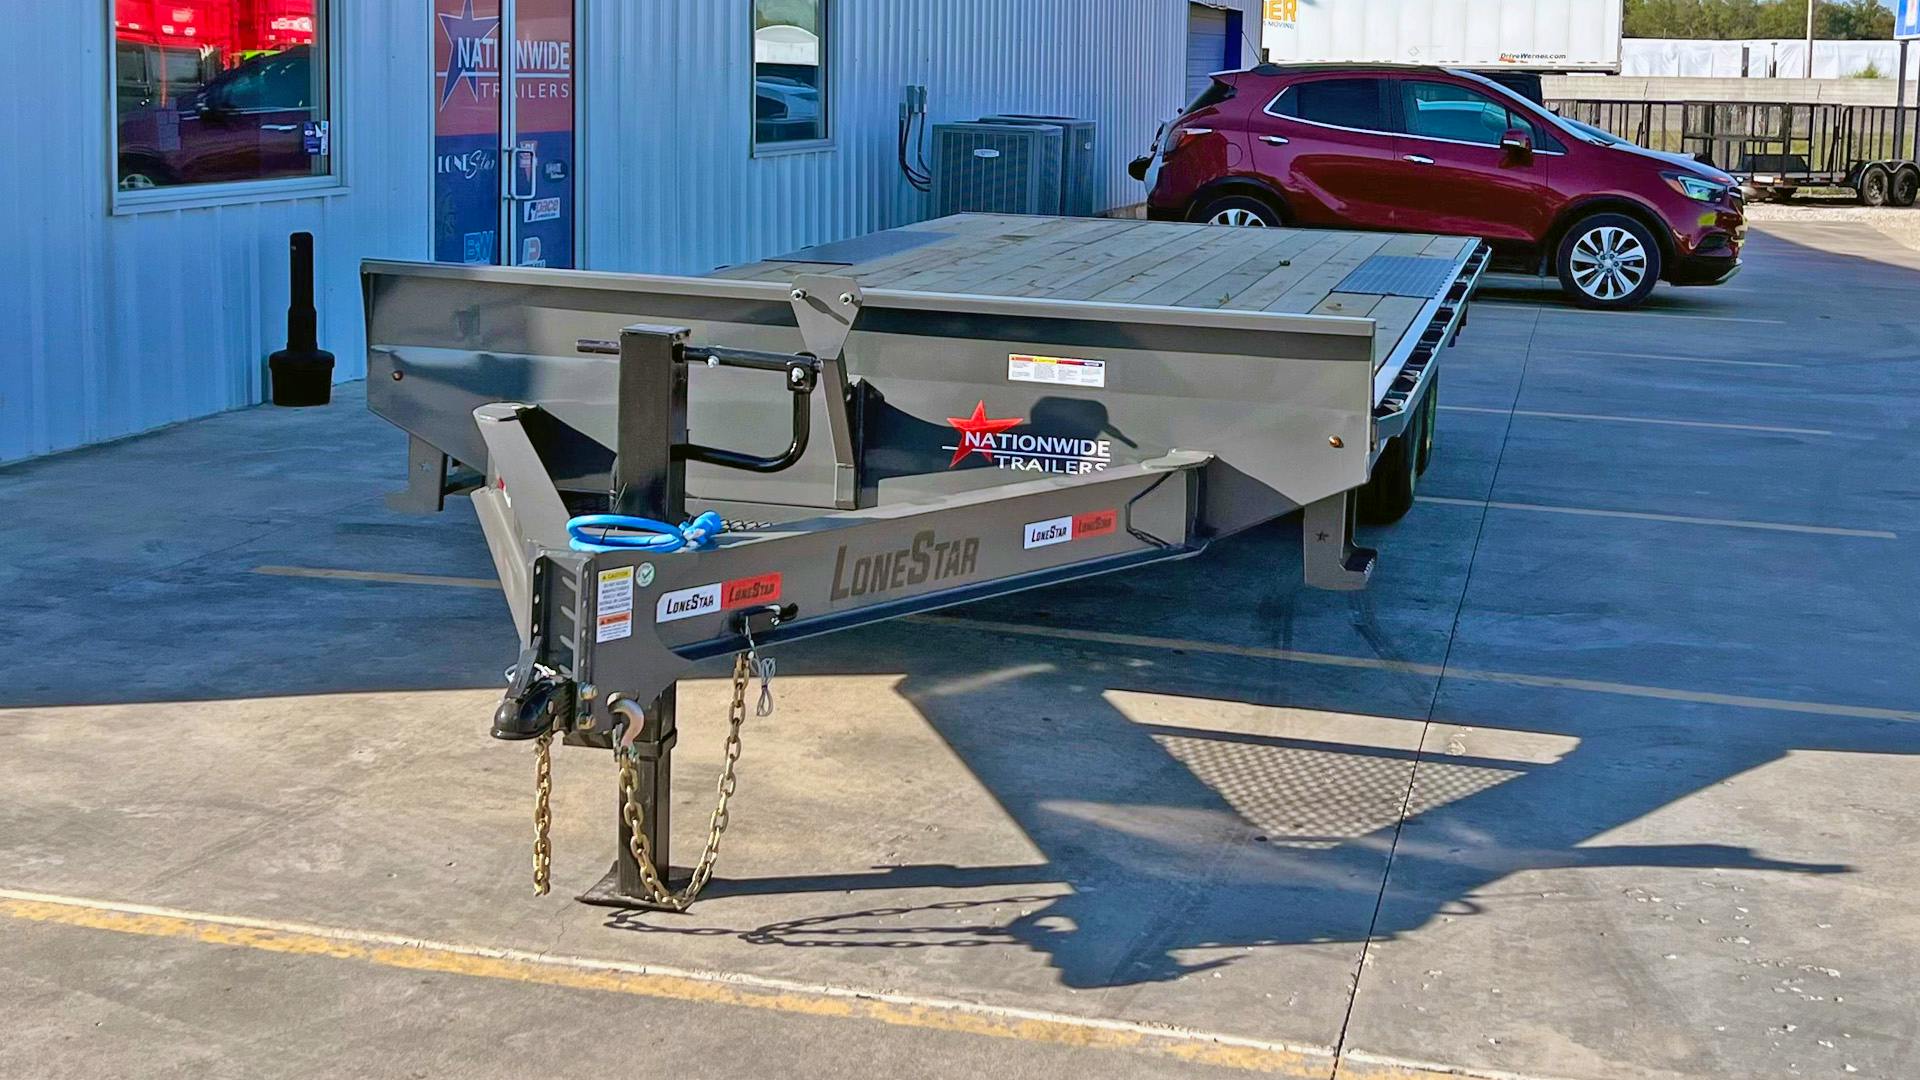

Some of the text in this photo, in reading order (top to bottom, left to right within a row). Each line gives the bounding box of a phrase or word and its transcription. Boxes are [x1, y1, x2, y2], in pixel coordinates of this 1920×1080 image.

[1264, 0, 1296, 22] ER
[457, 37, 570, 70] NATINWIDE
[480, 82, 569, 98] TRILERS
[965, 430, 1111, 457] NATIONWIDE
